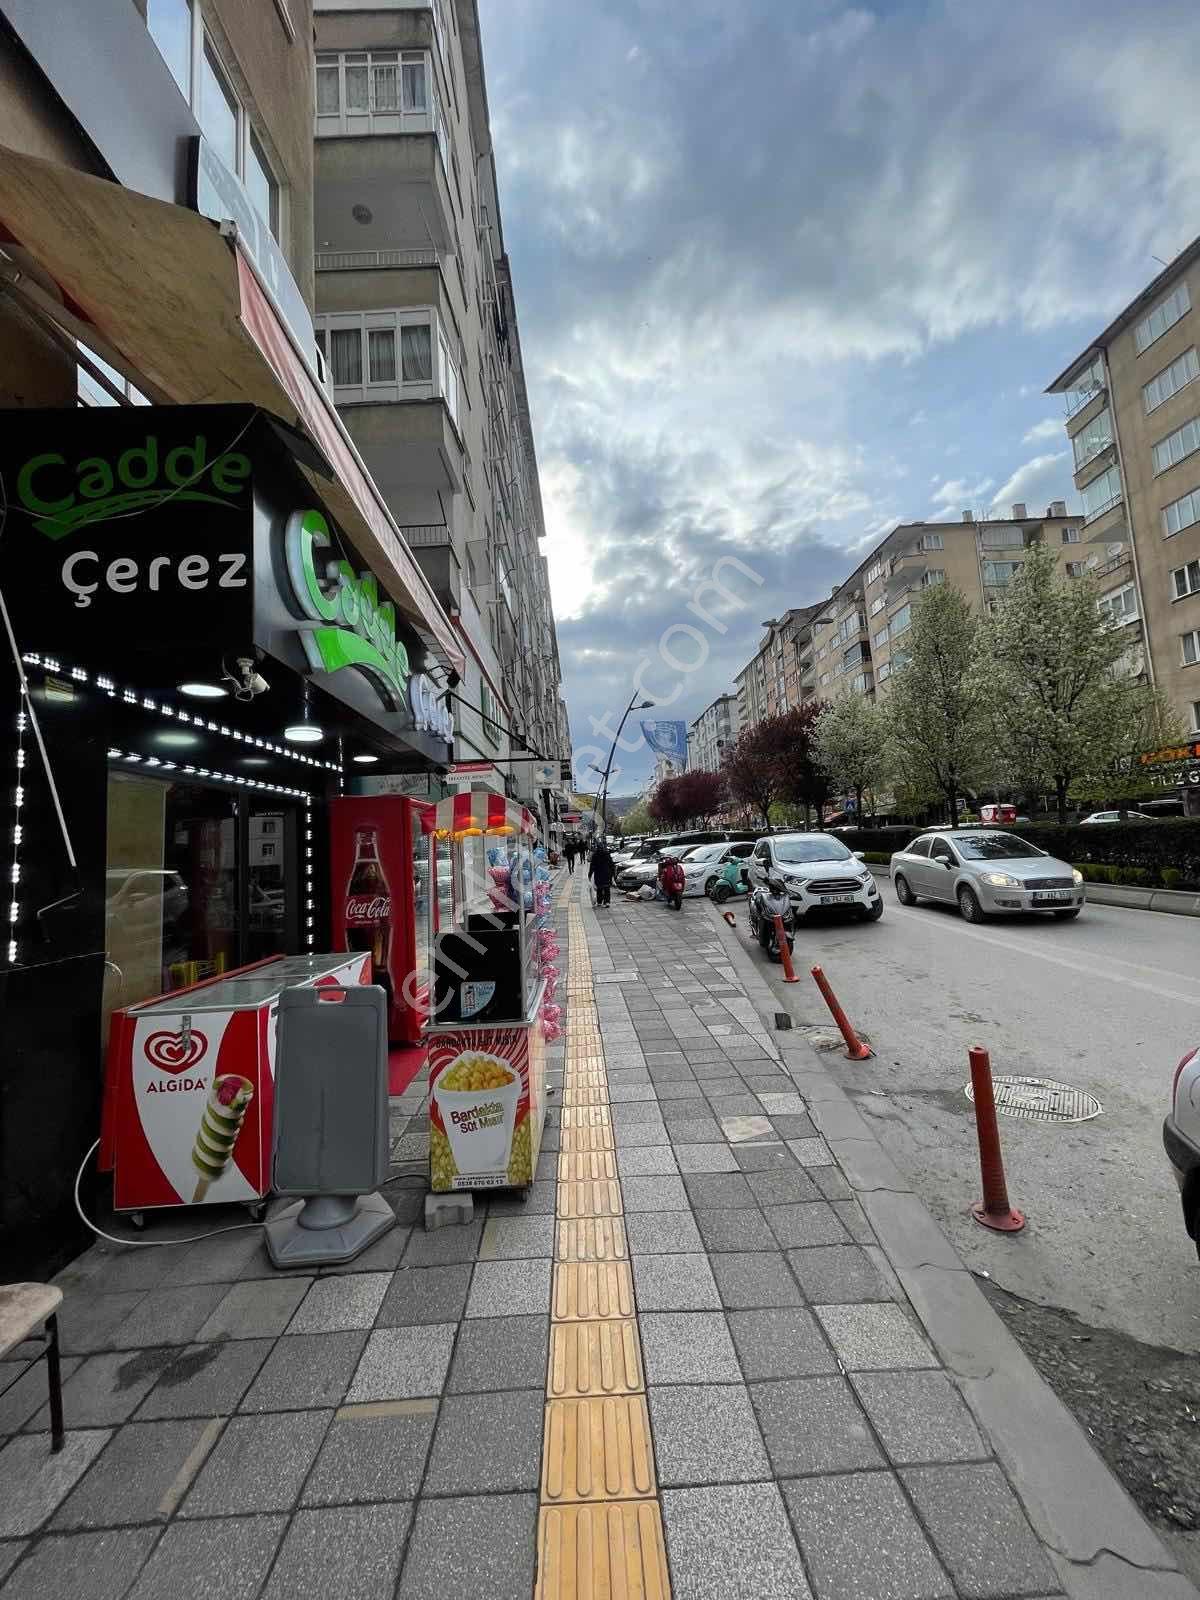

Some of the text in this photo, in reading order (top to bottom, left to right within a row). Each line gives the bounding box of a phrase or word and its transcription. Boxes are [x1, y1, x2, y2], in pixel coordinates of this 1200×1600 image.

[17, 435, 251, 513] Cadde
[61, 550, 248, 608] Çerez
[345, 896, 392, 920] Coca-Cola
